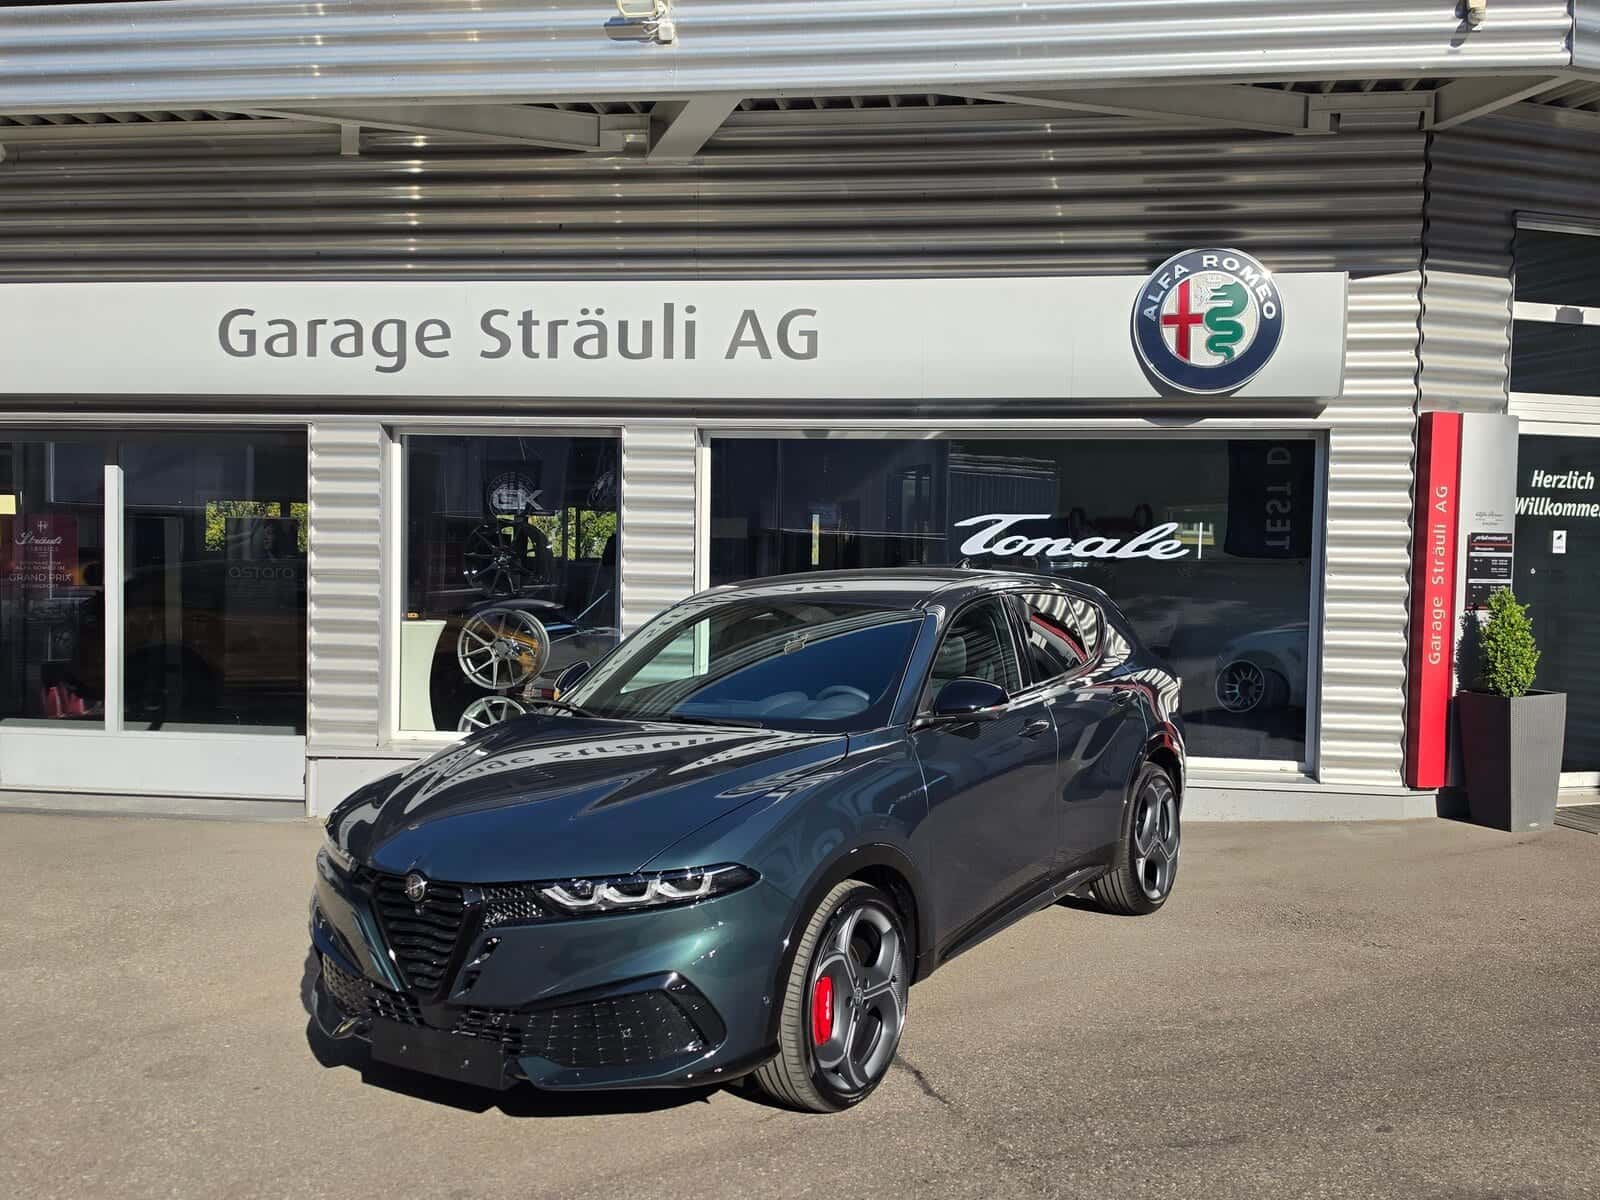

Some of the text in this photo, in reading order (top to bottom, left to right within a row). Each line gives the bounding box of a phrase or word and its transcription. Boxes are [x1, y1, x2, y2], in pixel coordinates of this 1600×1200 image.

[1144, 255, 1276, 321] ALFA ROMEO
[218, 302, 819, 373] Garage Sträuli AG
[1515, 496, 1600, 518] Willkomme
[1531, 469, 1595, 490] Herzlich
[954, 513, 1190, 560] Tonale
[1428, 485, 1449, 665] Garage Sträuli AG
